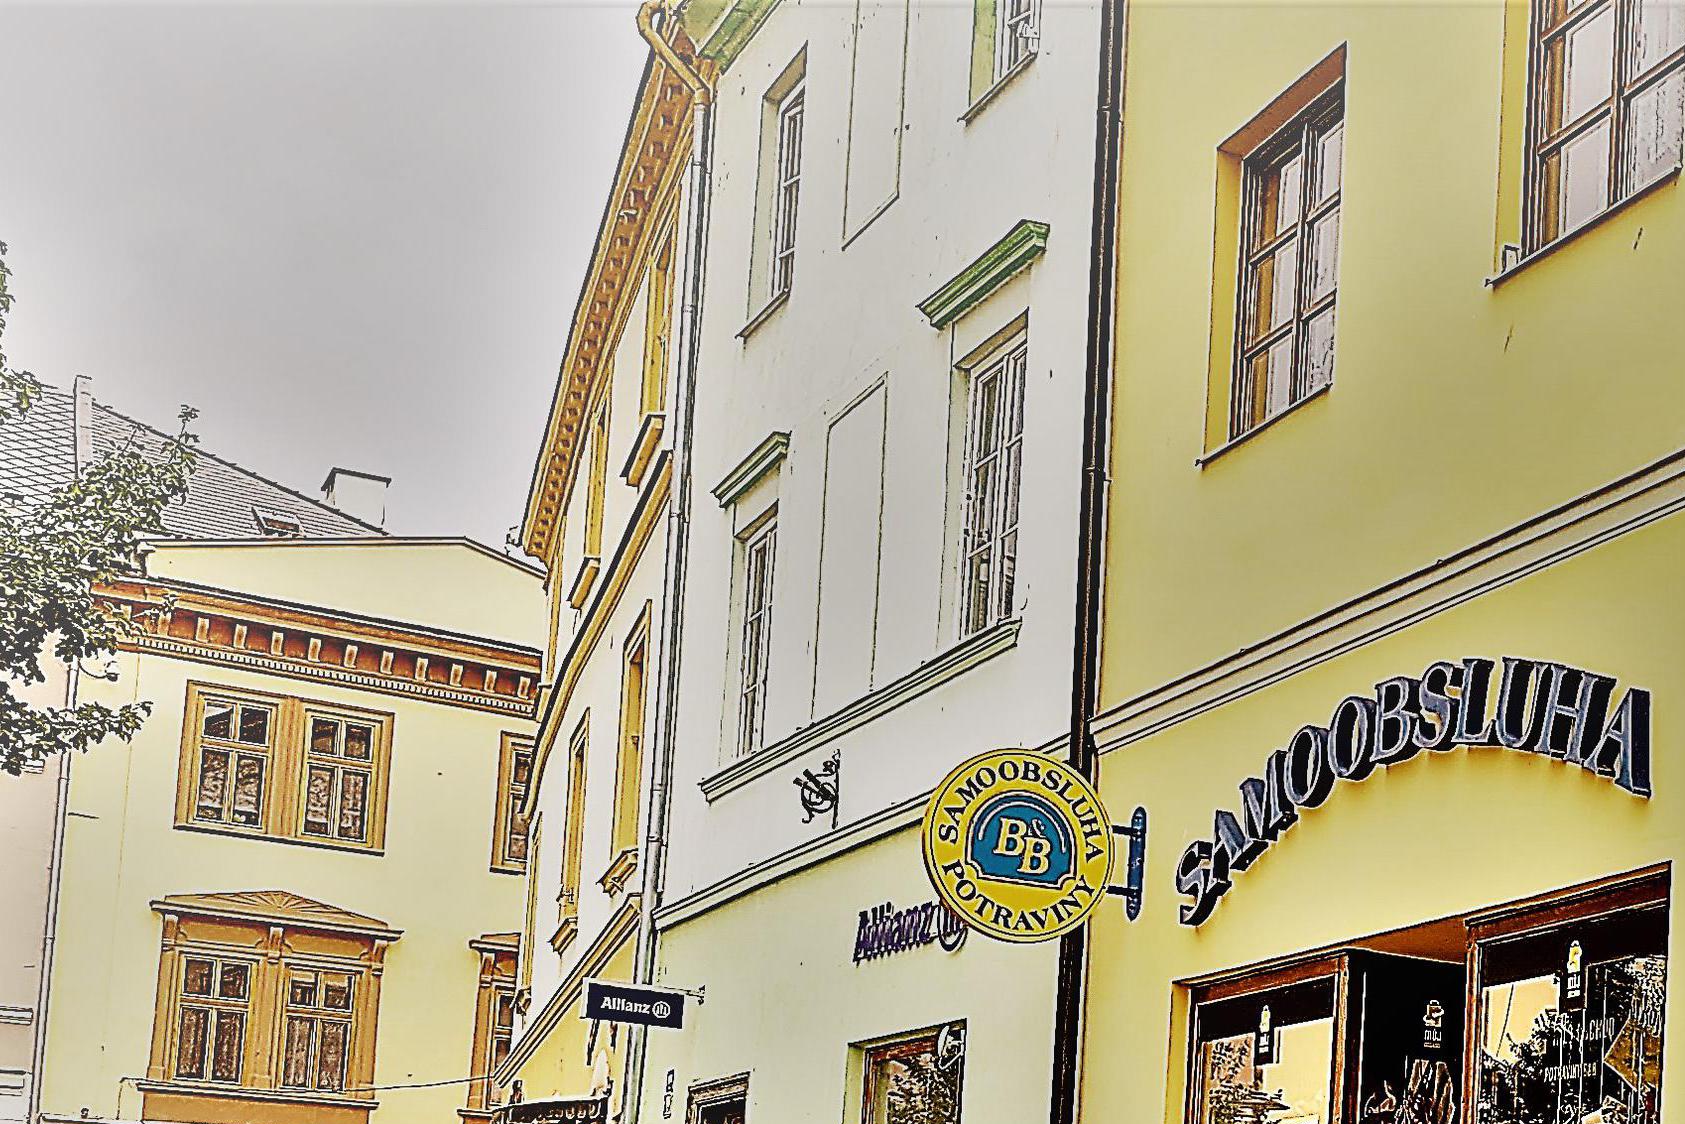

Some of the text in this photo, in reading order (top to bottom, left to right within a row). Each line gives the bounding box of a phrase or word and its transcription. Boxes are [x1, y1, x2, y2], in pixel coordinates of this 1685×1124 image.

[938, 760, 1104, 864] SAMOOBSLUHA
[1176, 656, 1652, 926] SAMOOBSLUHA
[941, 858, 1095, 931] POTRAVINY
[600, 996, 651, 1014] Allianz
